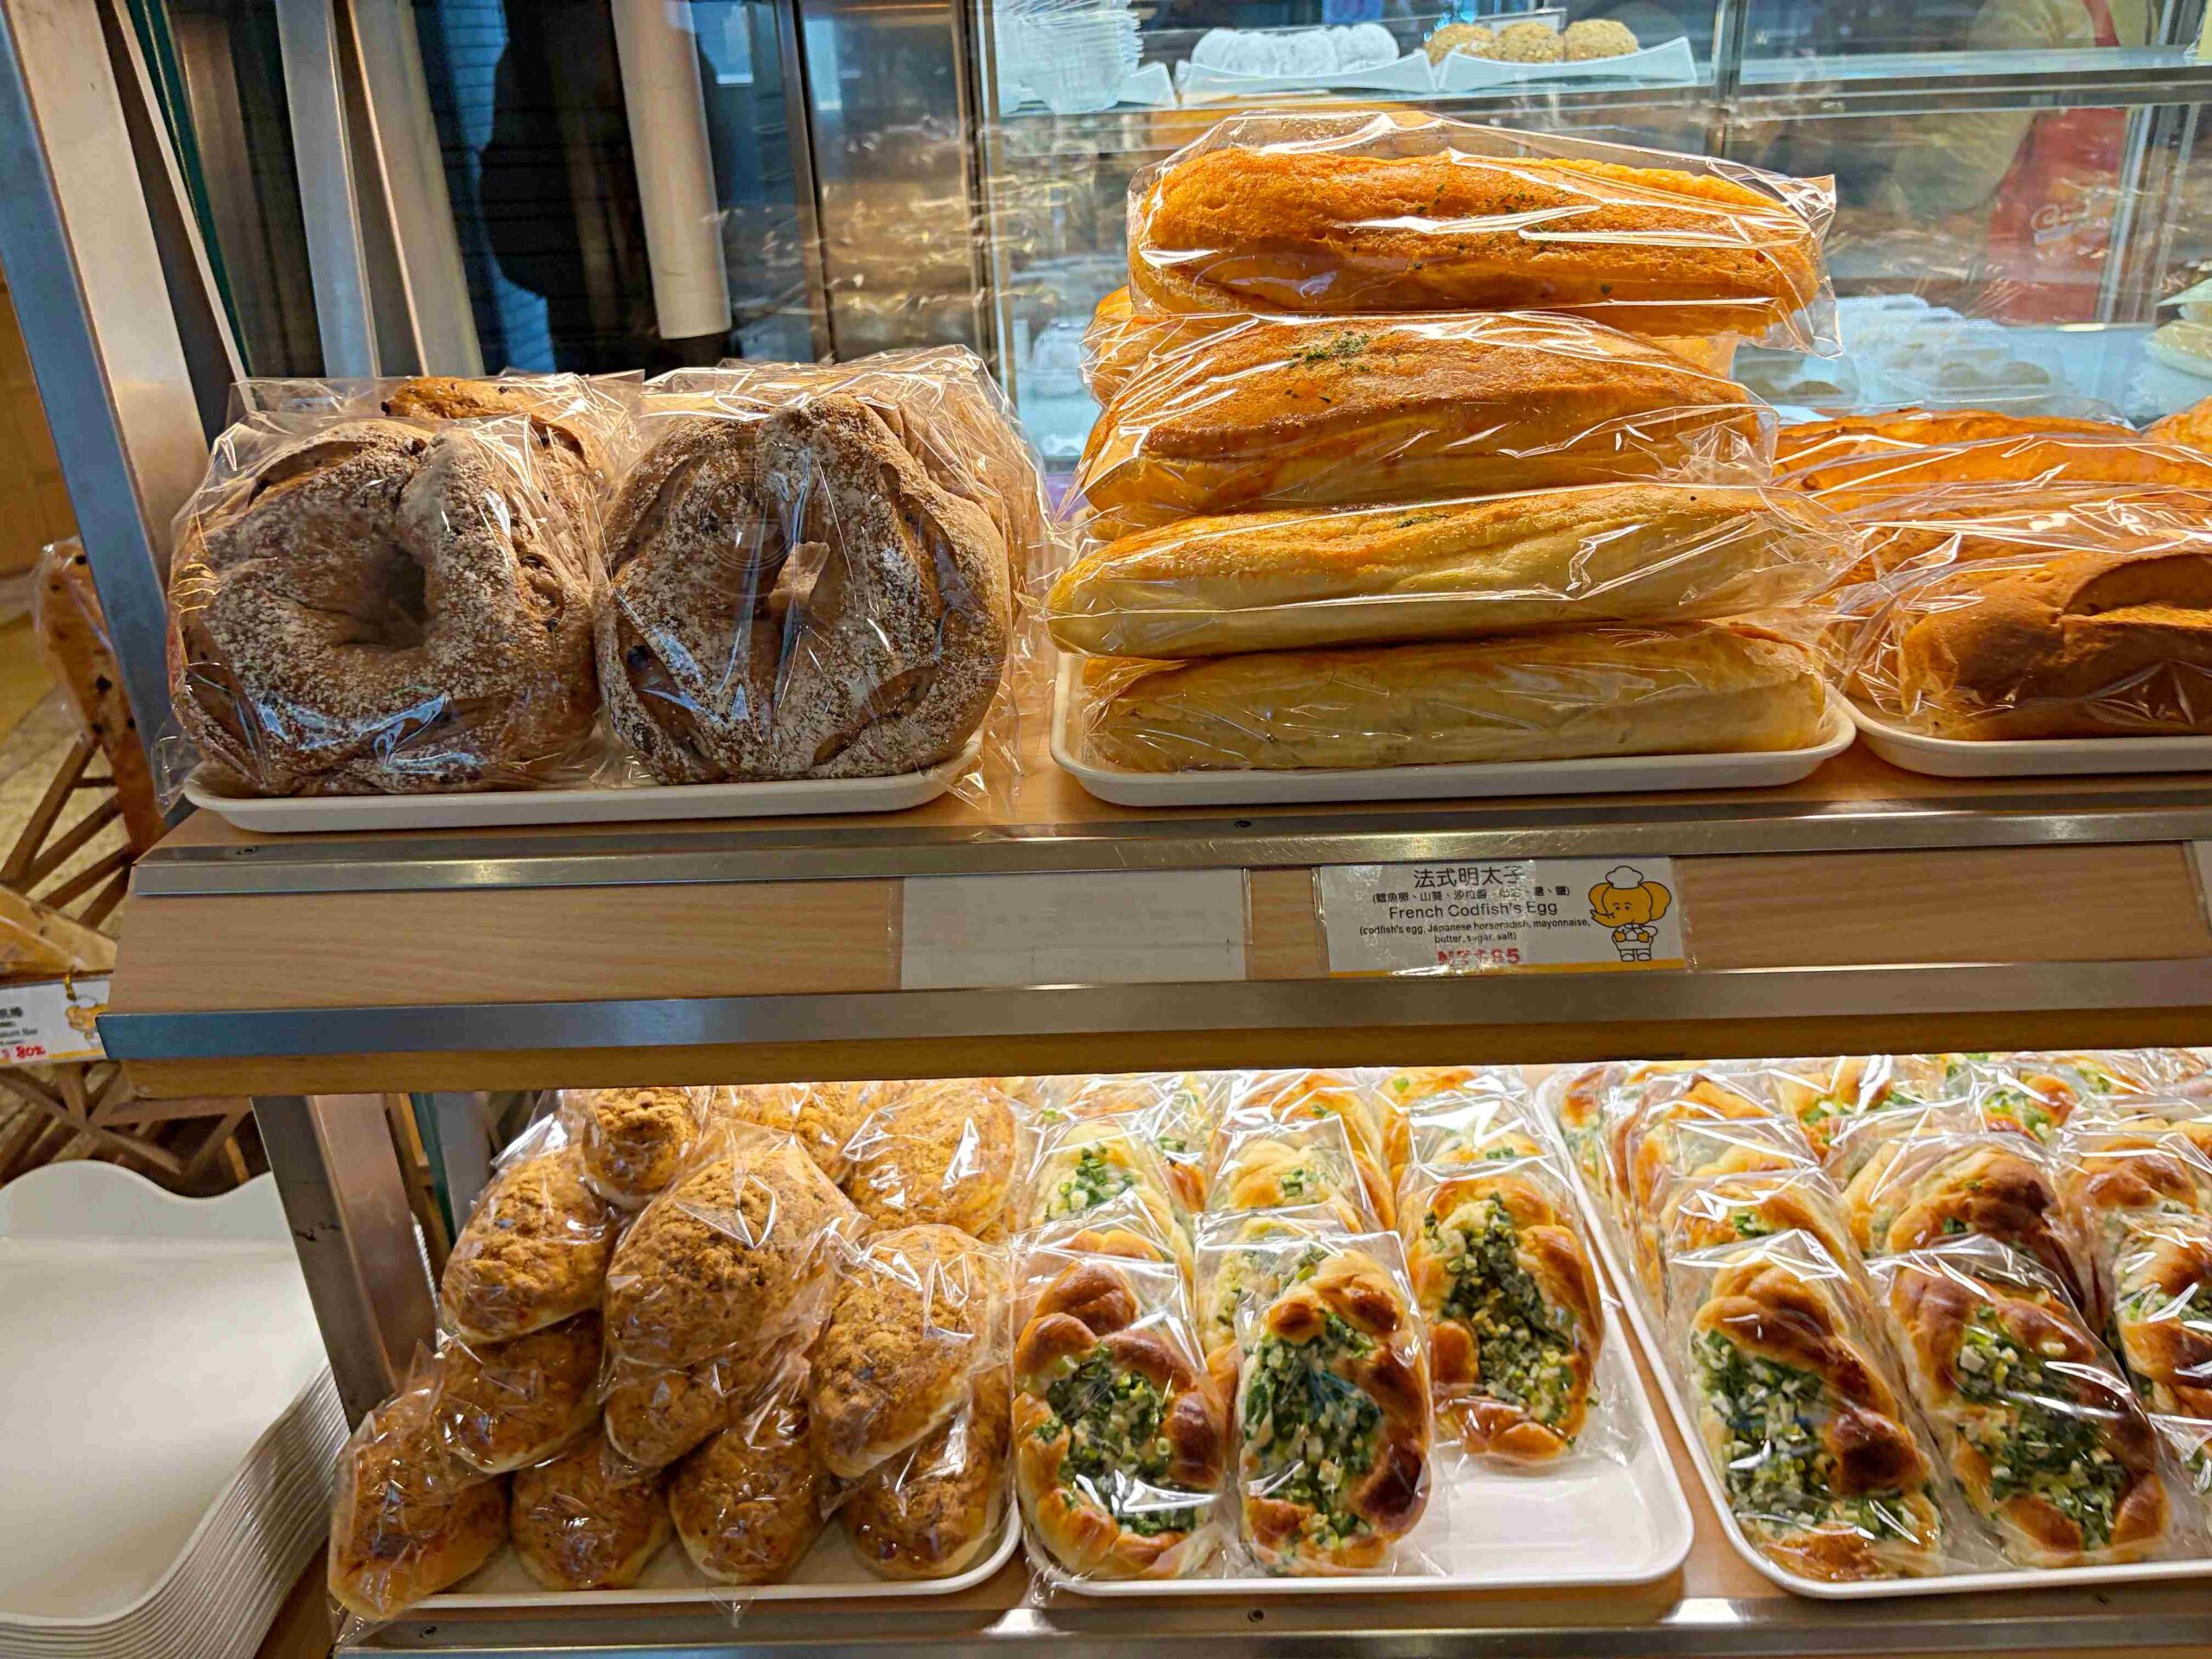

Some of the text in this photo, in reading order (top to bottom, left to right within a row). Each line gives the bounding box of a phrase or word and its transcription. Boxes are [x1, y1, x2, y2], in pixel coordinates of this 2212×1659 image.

[1414, 866, 1526, 888] 法式明太子
[1389, 900, 1558, 919] French Codfish's Egg
[1427, 922, 1471, 933] Japanese
[1533, 918, 1591, 930] mayonnaise,
[1497, 931, 1516, 942] salt)
